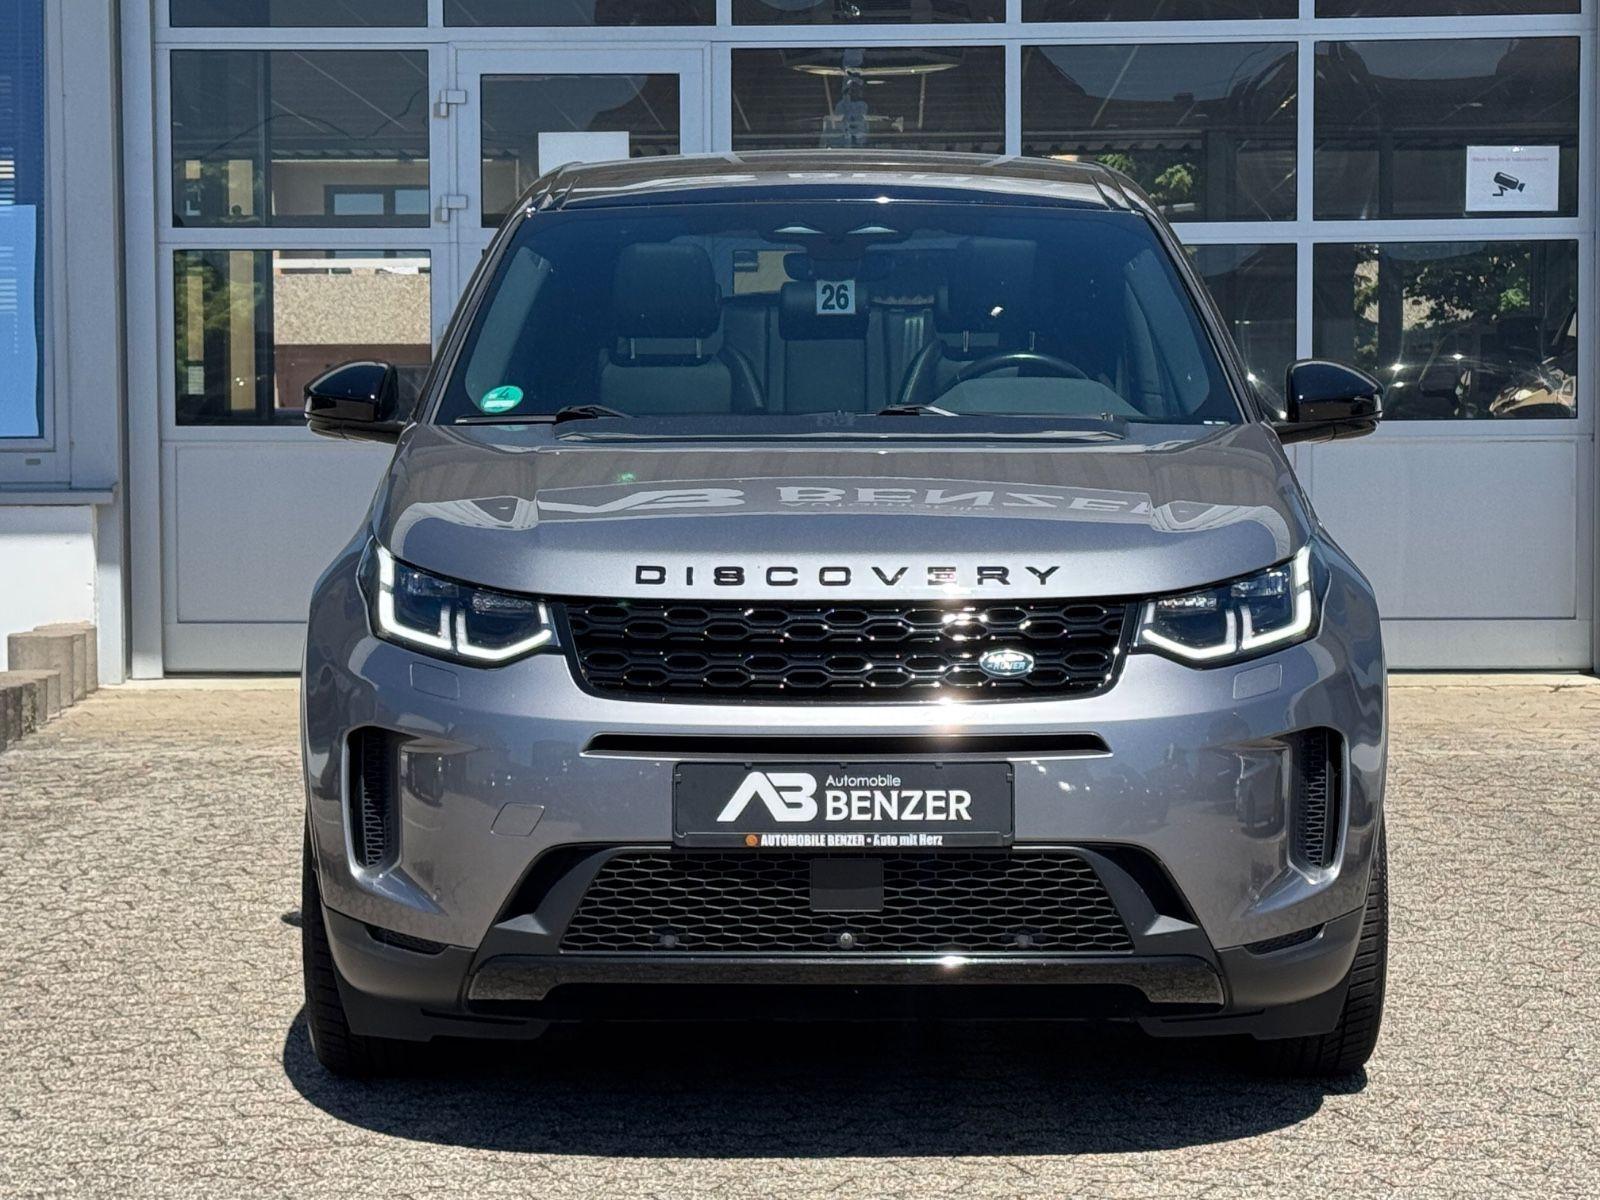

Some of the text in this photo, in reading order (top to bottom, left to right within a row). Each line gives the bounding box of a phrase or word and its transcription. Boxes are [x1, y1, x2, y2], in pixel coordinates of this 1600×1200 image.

[821, 284, 850, 310] 26
[635, 565, 1061, 586] DISCOVERY
[825, 774, 902, 787] Automobile
[825, 790, 972, 821] BENZER
[760, 834, 943, 847] AUTOMOBILE BENZER Auto mit Herz
